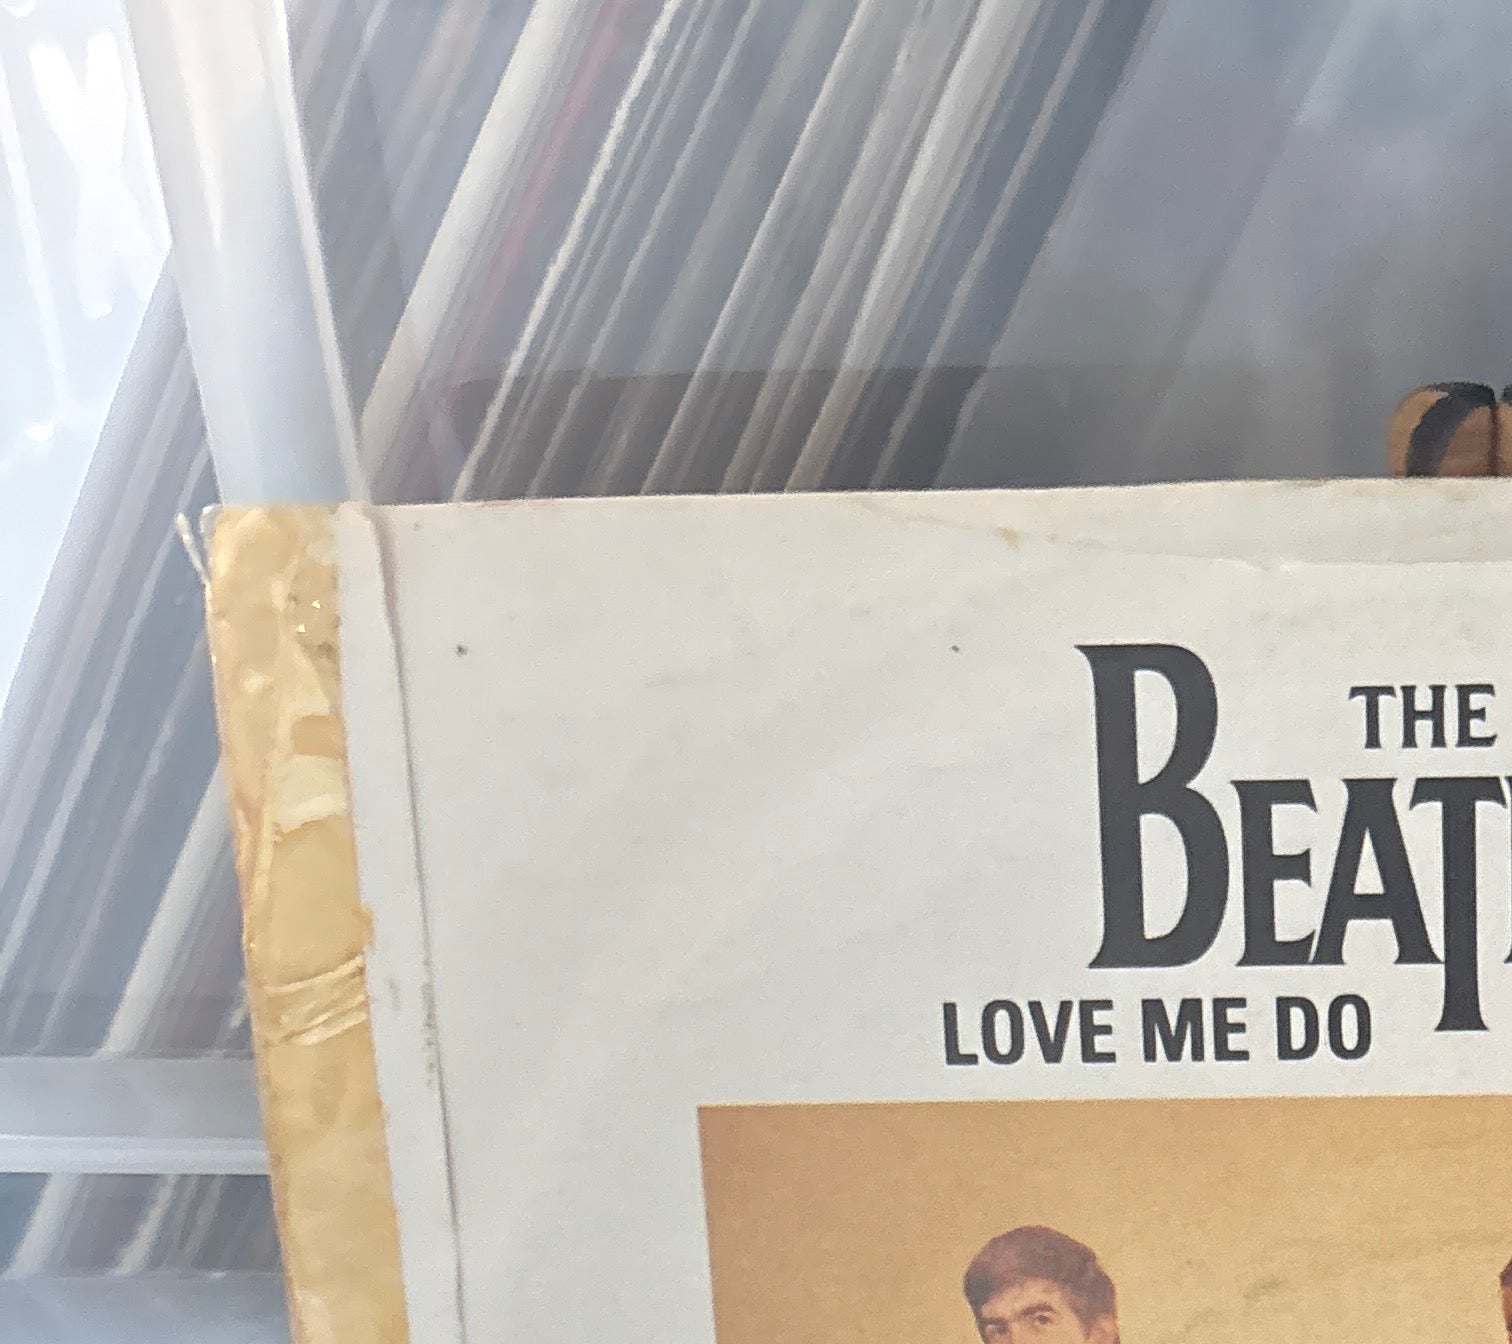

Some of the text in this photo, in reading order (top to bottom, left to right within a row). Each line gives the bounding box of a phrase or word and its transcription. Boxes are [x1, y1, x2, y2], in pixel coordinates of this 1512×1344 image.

[1348, 683, 1498, 749] THE
[942, 993, 1372, 1066] LOVE ME DO
